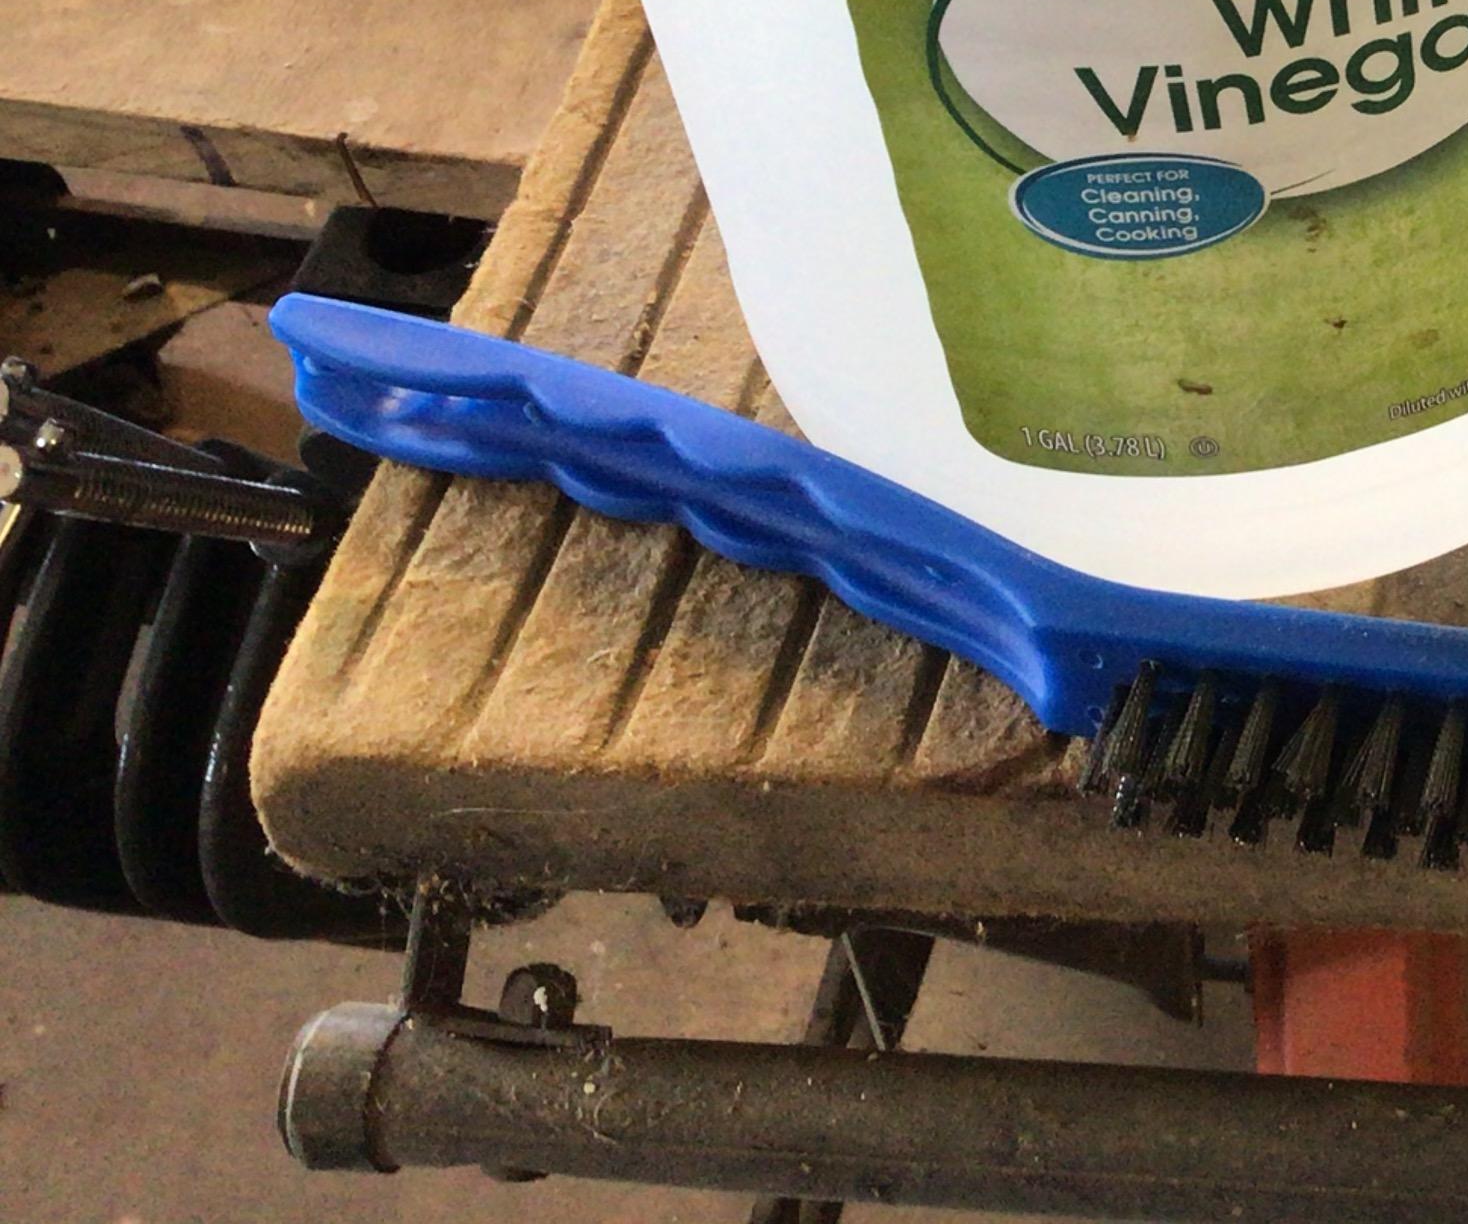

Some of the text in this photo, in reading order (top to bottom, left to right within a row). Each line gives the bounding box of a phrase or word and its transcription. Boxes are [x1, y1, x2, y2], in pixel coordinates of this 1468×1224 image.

[1087, 168, 1191, 184] PERFECT FOR
[1080, 186, 1200, 205] Cleaning,
[1088, 206, 1200, 225] Canning,
[1095, 225, 1198, 243] Cooking
[1388, 386, 1447, 422] Diluted
[1021, 426, 1167, 460] 1 GAL (3.78 L)
